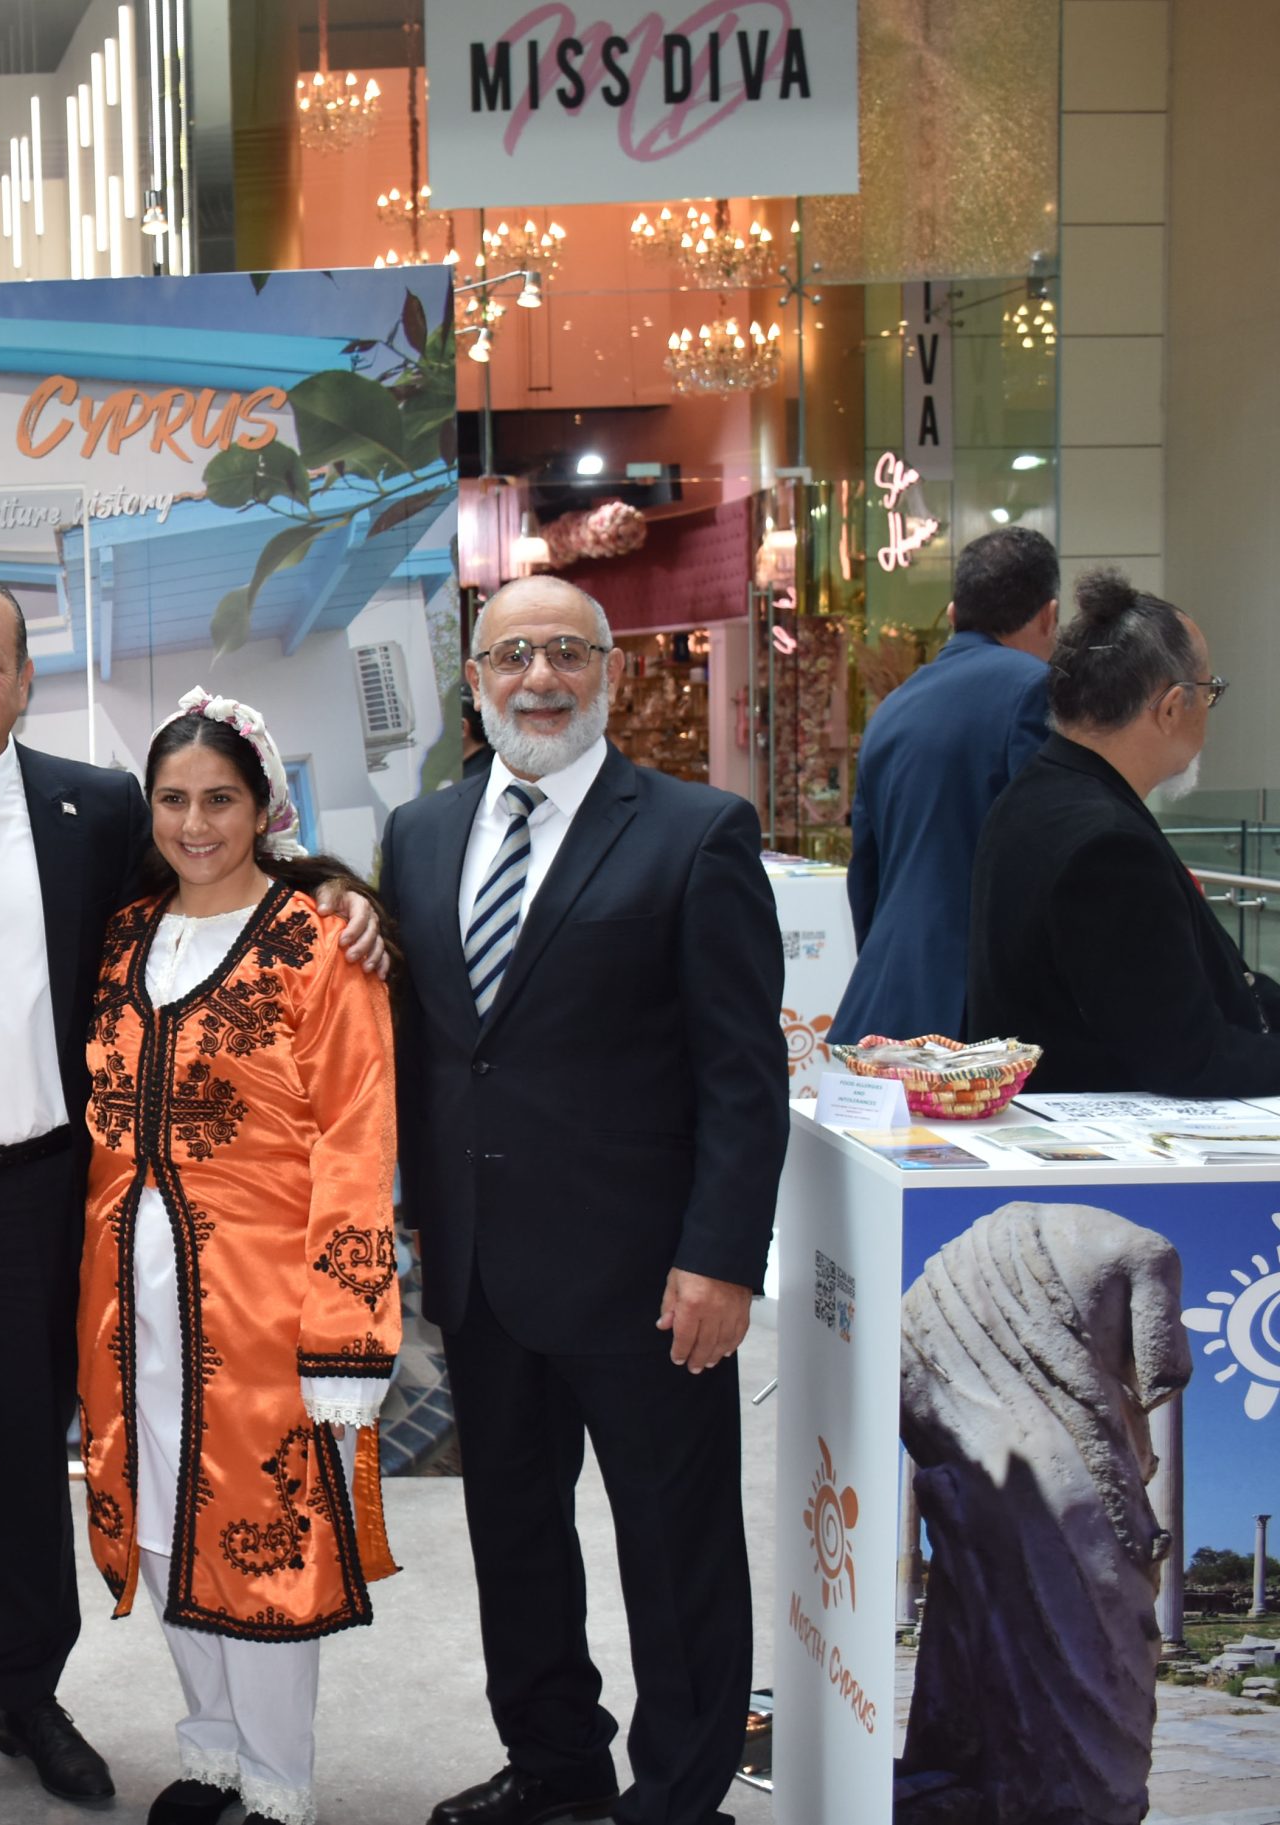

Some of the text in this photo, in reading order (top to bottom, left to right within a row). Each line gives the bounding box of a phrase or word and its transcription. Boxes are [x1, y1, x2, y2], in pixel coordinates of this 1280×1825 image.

[470, 28, 812, 112] MISS DIVA
[16, 375, 288, 463] CYPRUS
[73, 486, 175, 525] history
[789, 1590, 877, 1734] NORTH CYPRUS
